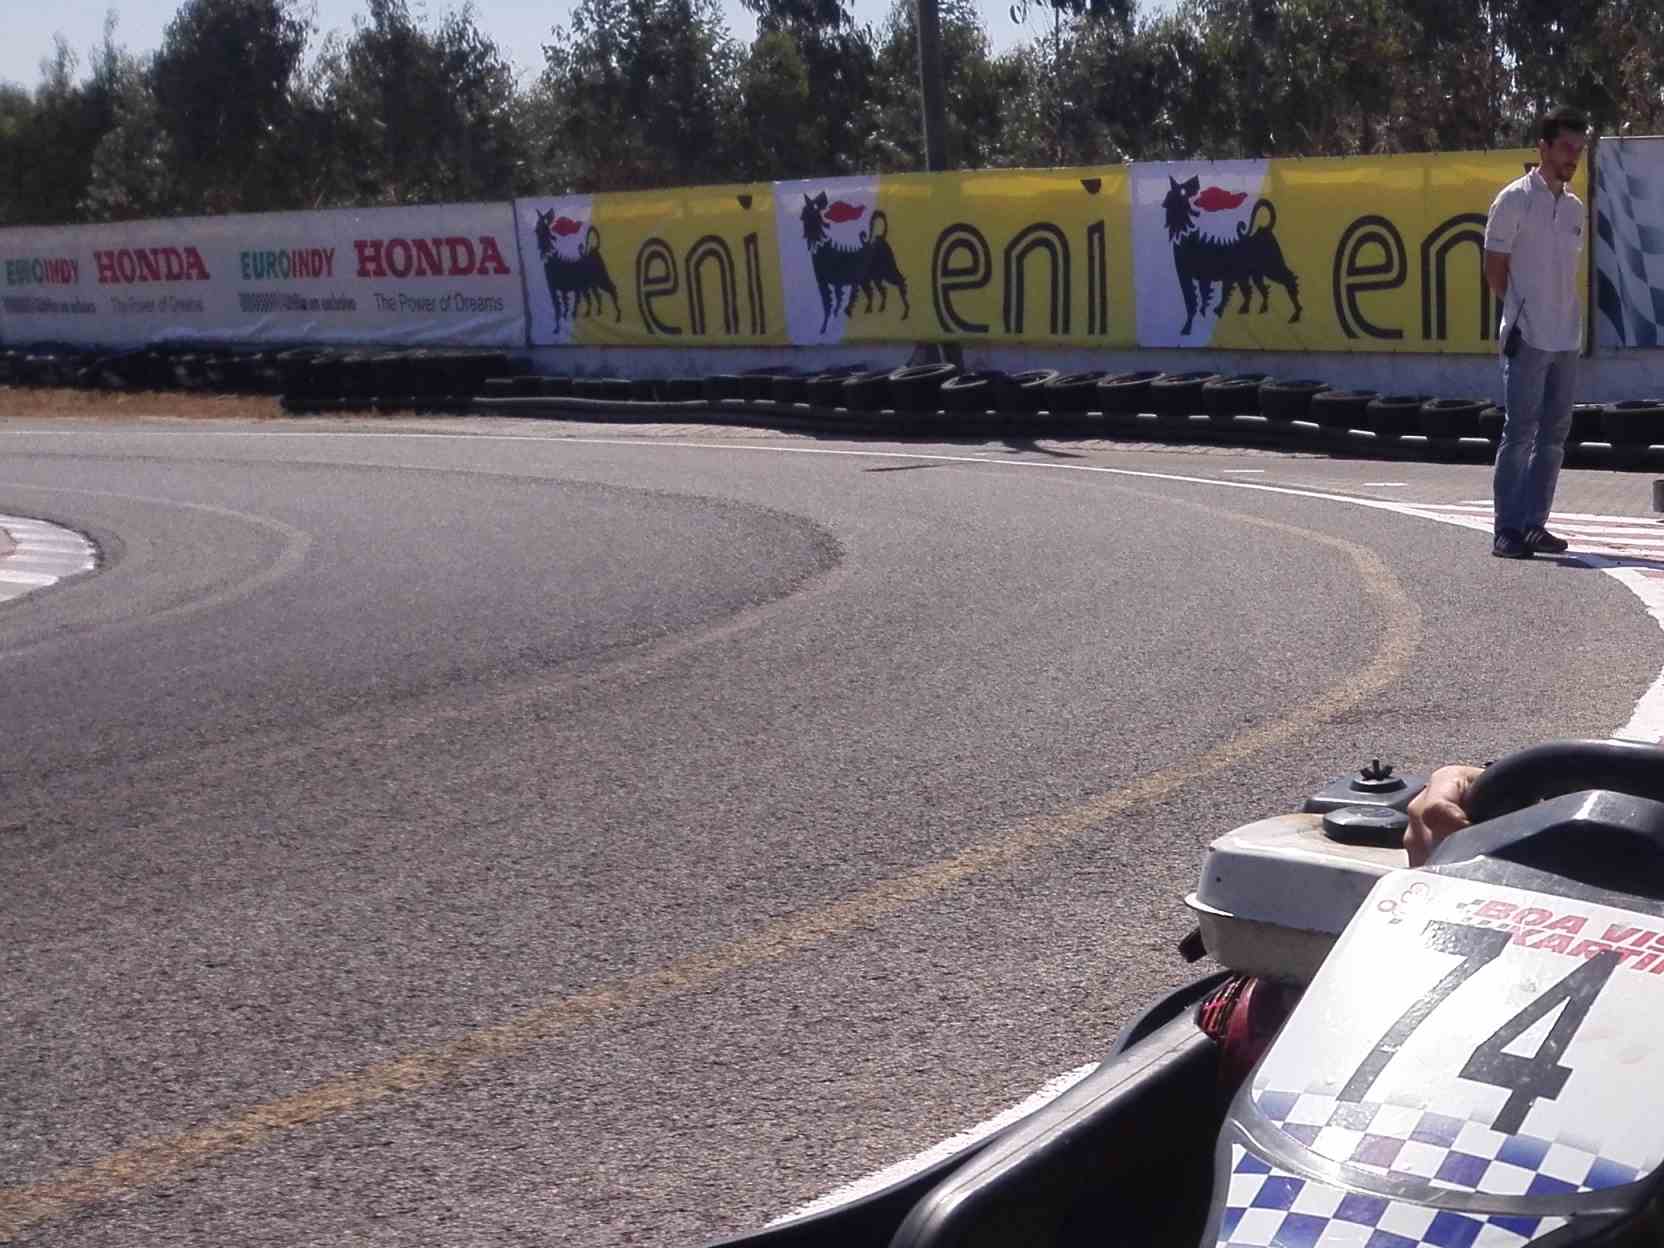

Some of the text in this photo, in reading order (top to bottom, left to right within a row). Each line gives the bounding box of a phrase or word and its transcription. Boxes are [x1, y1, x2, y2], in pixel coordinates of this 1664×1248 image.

[93, 247, 210, 284] HONDA
[240, 235, 511, 281] EUROINDY HONDA
[931, 178, 1108, 335] eni
[1333, 213, 1502, 340] en
[373, 292, 396, 310] The
[399, 293, 437, 311] Power
[441, 292, 453, 309] of
[455, 291, 504, 312] Dreams
[1473, 900, 1589, 935] BOA
[1326, 919, 1623, 1136] 74
